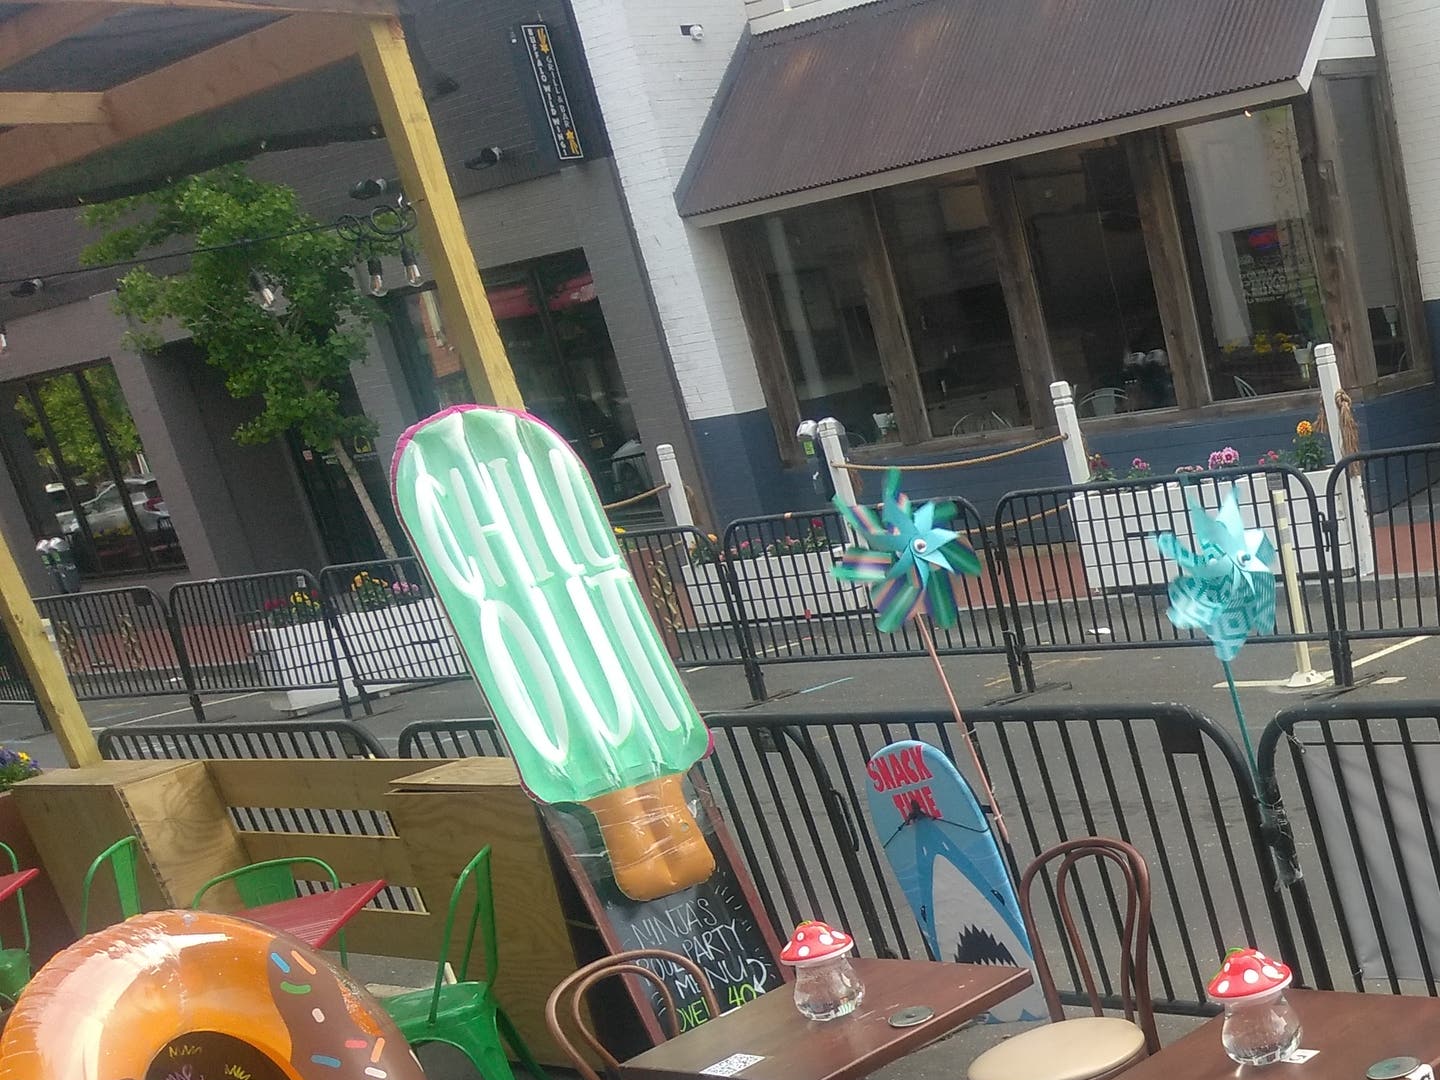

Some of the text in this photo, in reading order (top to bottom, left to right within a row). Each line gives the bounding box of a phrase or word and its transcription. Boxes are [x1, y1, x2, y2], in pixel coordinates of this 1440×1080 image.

[527, 28, 548, 82] BUFFALO
[543, 84, 557, 116] WILD
[545, 55, 560, 94] GRILL
[559, 104, 570, 128] BAR
[415, 447, 620, 600] CHILL
[480, 566, 682, 764] OUT
[866, 745, 933, 792] SNACK
[892, 786, 944, 825] TIME
[631, 898, 718, 949] NINJA'S
[682, 918, 745, 963] PARTY
